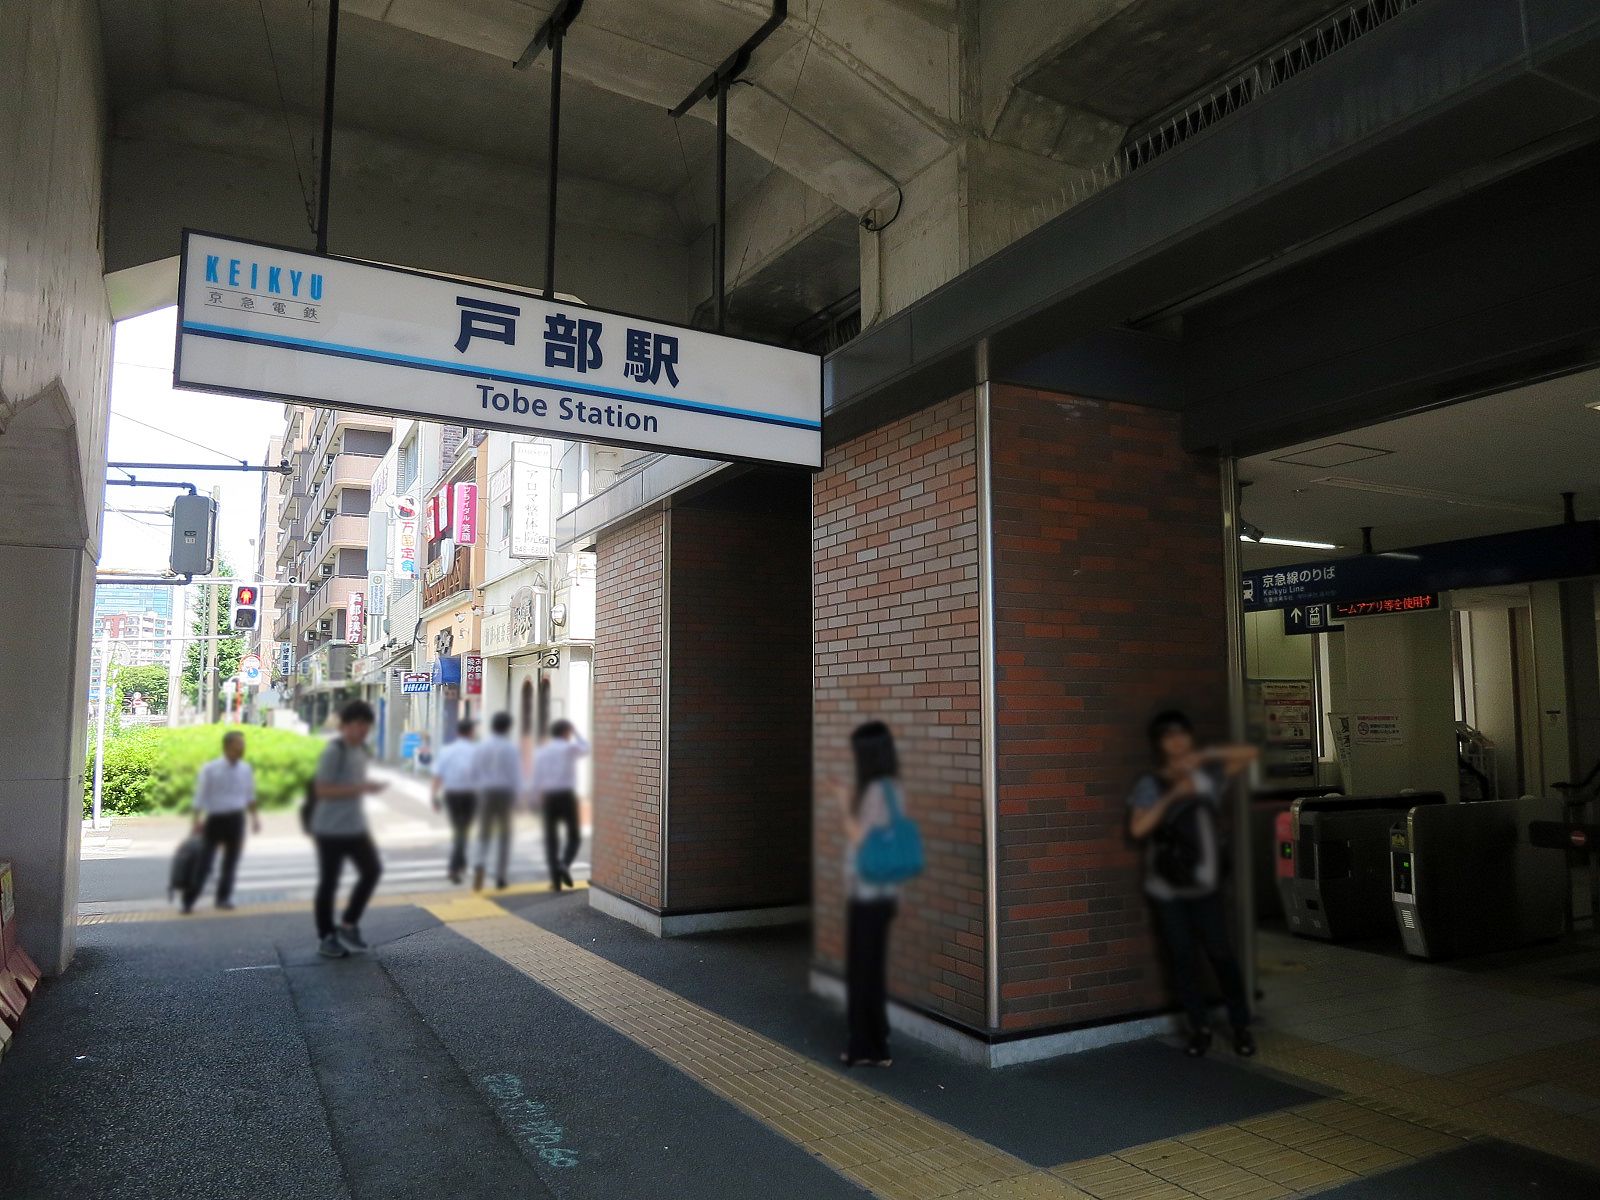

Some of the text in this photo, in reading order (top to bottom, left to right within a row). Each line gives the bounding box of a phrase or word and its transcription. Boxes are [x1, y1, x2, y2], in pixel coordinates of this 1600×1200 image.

[205, 255, 323, 301] KEIKYU
[208, 291, 319, 320] 京急電鉄
[454, 296, 680, 389] 戸部駅
[476, 384, 659, 433] Tobe Station
[1262, 565, 1336, 588] 京急線のりば
[1289, 585, 1305, 595] Line
[349, 593, 362, 643] 戸部の漢方
[1337, 595, 1432, 616] ームアプリ等を使用す
